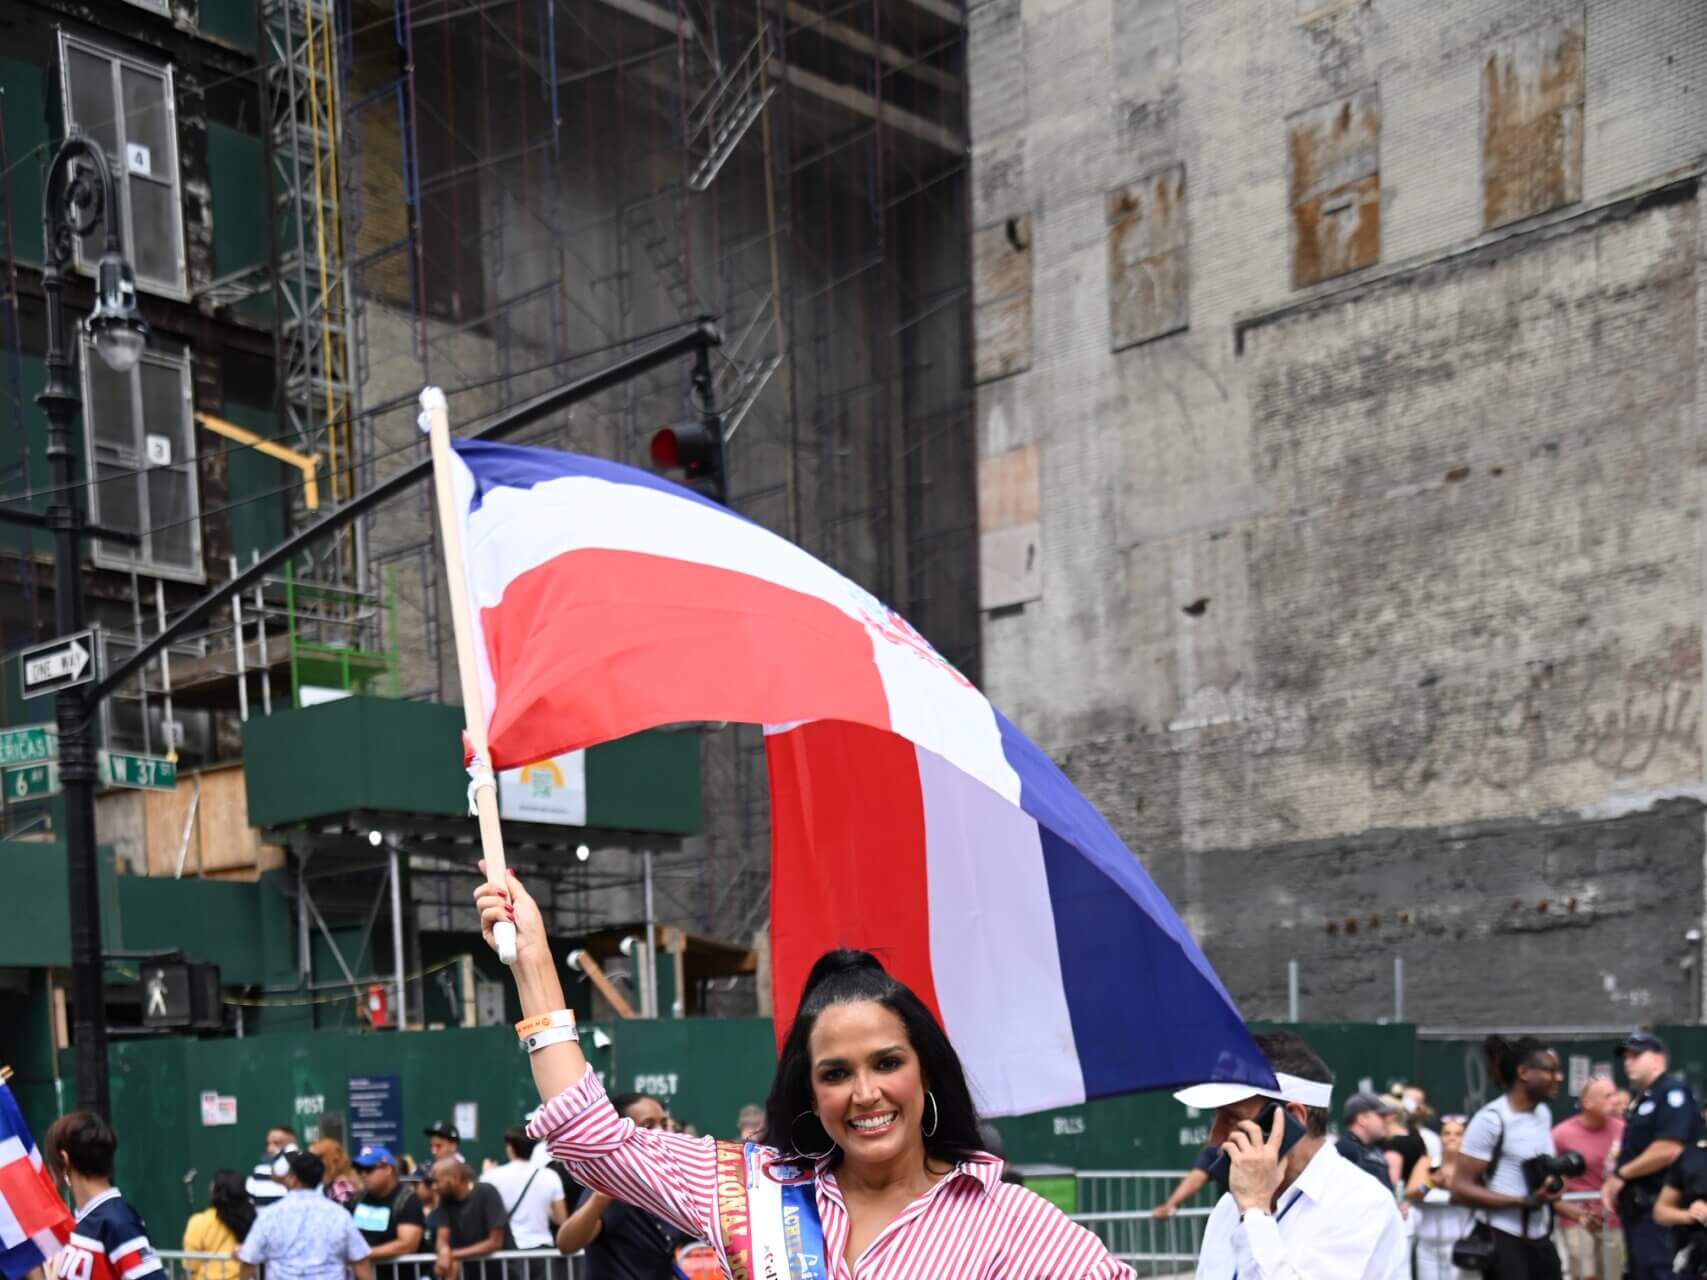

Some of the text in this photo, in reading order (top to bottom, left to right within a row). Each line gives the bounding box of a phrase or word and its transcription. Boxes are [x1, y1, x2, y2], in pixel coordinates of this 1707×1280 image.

[32, 652, 82, 681] ONE WAY
[16, 770, 28, 797] 6
[112, 757, 127, 783] W
[137, 760, 156, 785] 37
[635, 1073, 678, 1095] POST
[295, 1095, 324, 1115] POST
[716, 1141, 750, 1248] NATIONAL
